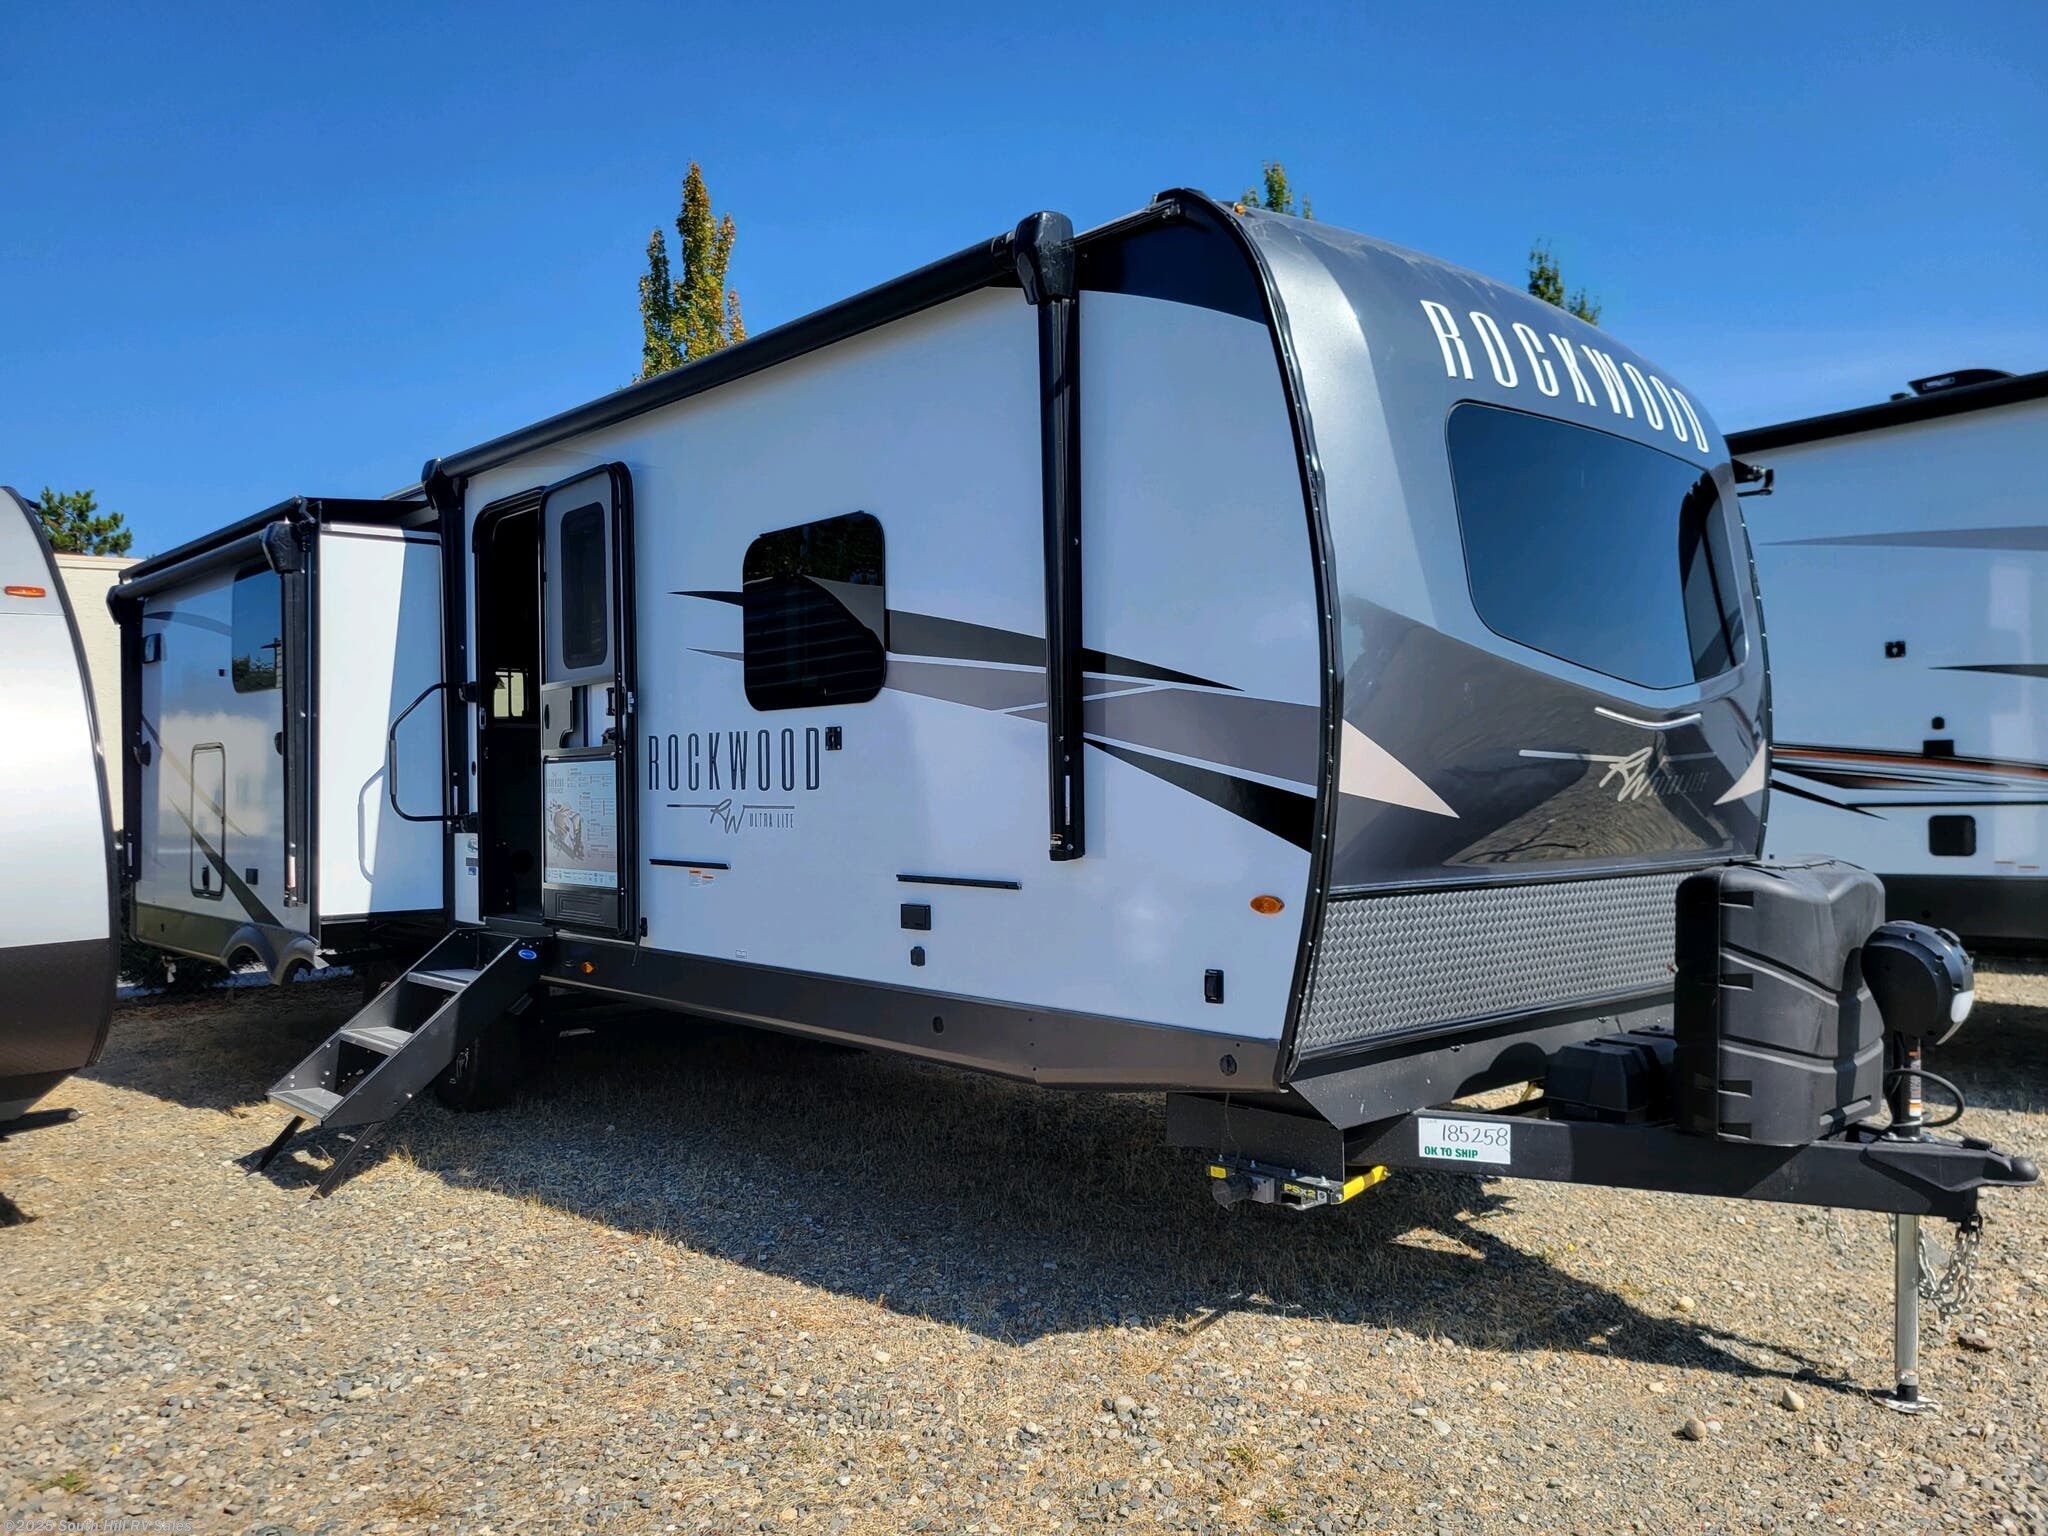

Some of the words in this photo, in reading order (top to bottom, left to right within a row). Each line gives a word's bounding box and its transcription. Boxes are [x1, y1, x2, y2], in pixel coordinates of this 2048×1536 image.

[1420, 300, 1709, 453] ROCKWOOD
[649, 728, 820, 791] ROCKWOOD
[749, 813, 773, 829] ULTRA
[776, 813, 795, 829] LITE
[1442, 1124, 1508, 1146] 185258
[1424, 1145, 1438, 1156] OK
[1440, 1147, 1452, 1157] TO
[1455, 1148, 1479, 1159] SHIP
